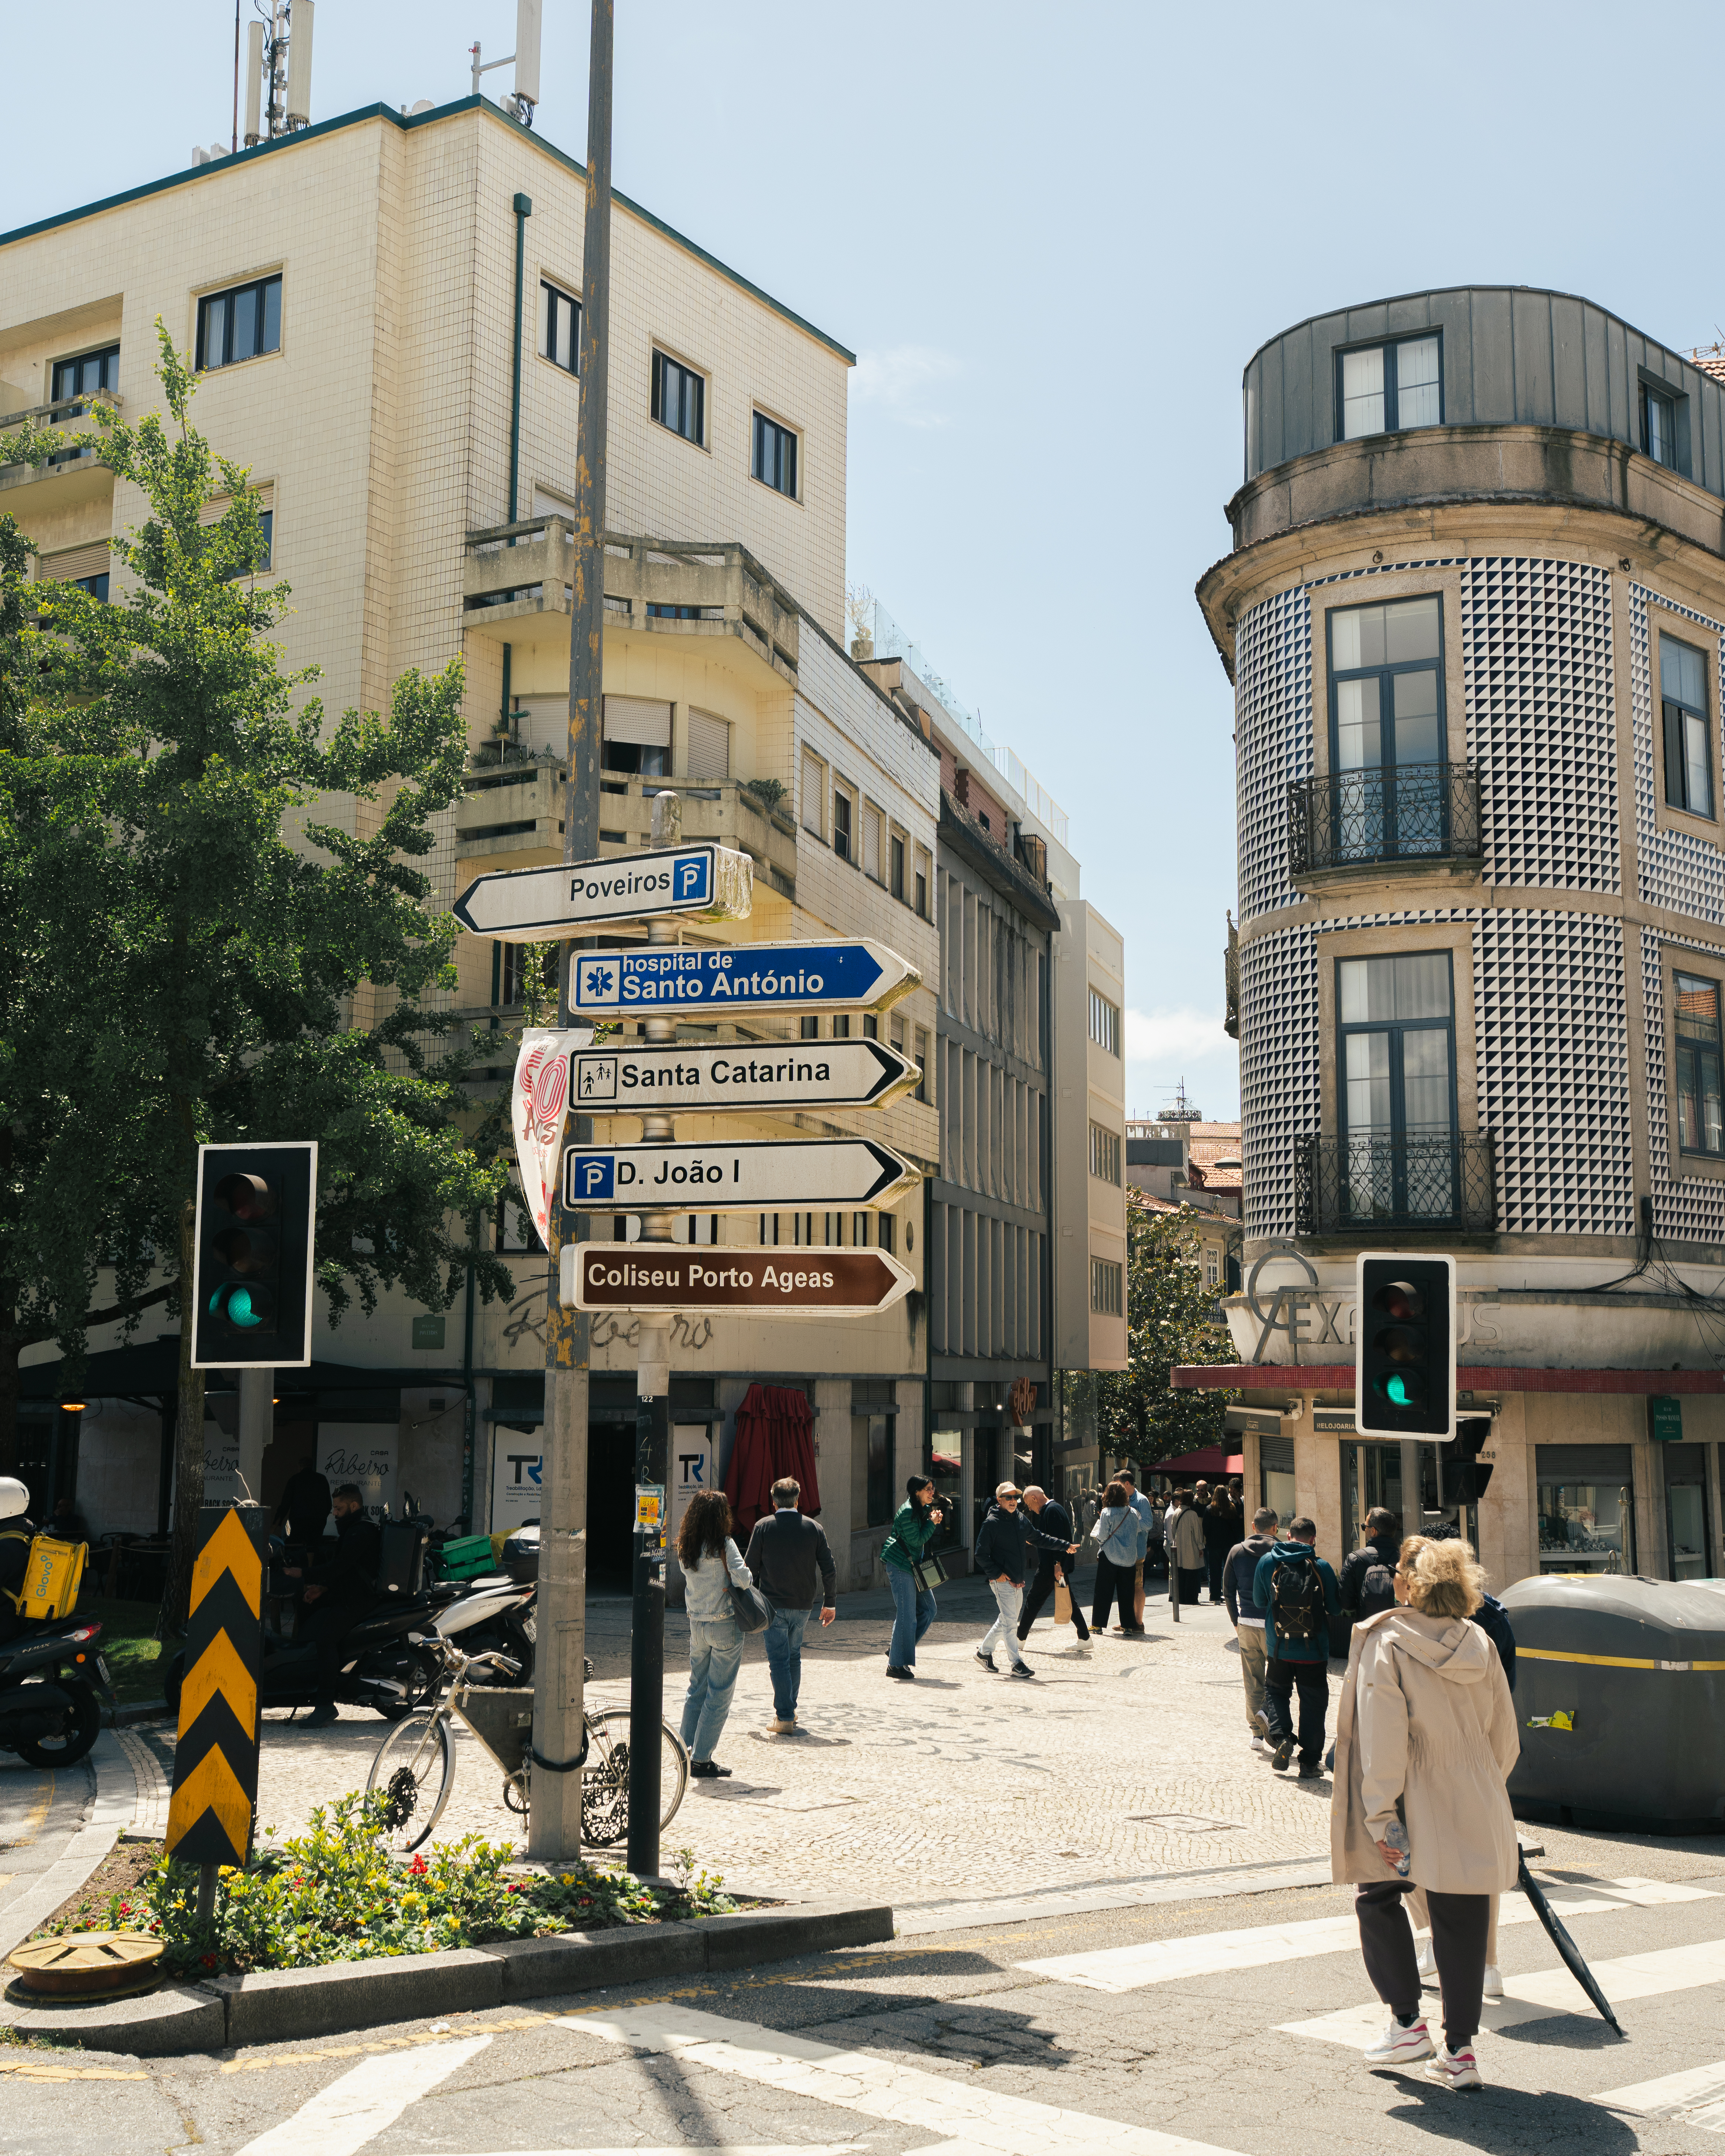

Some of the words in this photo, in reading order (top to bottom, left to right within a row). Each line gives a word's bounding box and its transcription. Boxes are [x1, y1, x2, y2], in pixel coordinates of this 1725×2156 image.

[570, 872, 670, 901] Poveiros
[623, 952, 702, 975] hospital
[709, 951, 733, 969] de
[623, 974, 703, 999] Santo
[710, 969, 824, 996] António
[621, 1063, 700, 1088] Santa
[711, 1058, 830, 1084] Catarina
[617, 1161, 644, 1185] D.
[654, 1160, 723, 1184] João
[734, 1159, 739, 1182] I
[589, 1263, 679, 1287] Coliseu
[689, 1265, 753, 1287] Porto
[761, 1266, 834, 1292] Ageas
[325, 1449, 390, 1476] Ribeiro
[507, 1455, 543, 1484] TR
[641, 1464, 654, 1485] R
[679, 1454, 704, 1483] TR
[651, 1547, 666, 1557] AGGREG
[36, 1562, 53, 1597] Glovo
